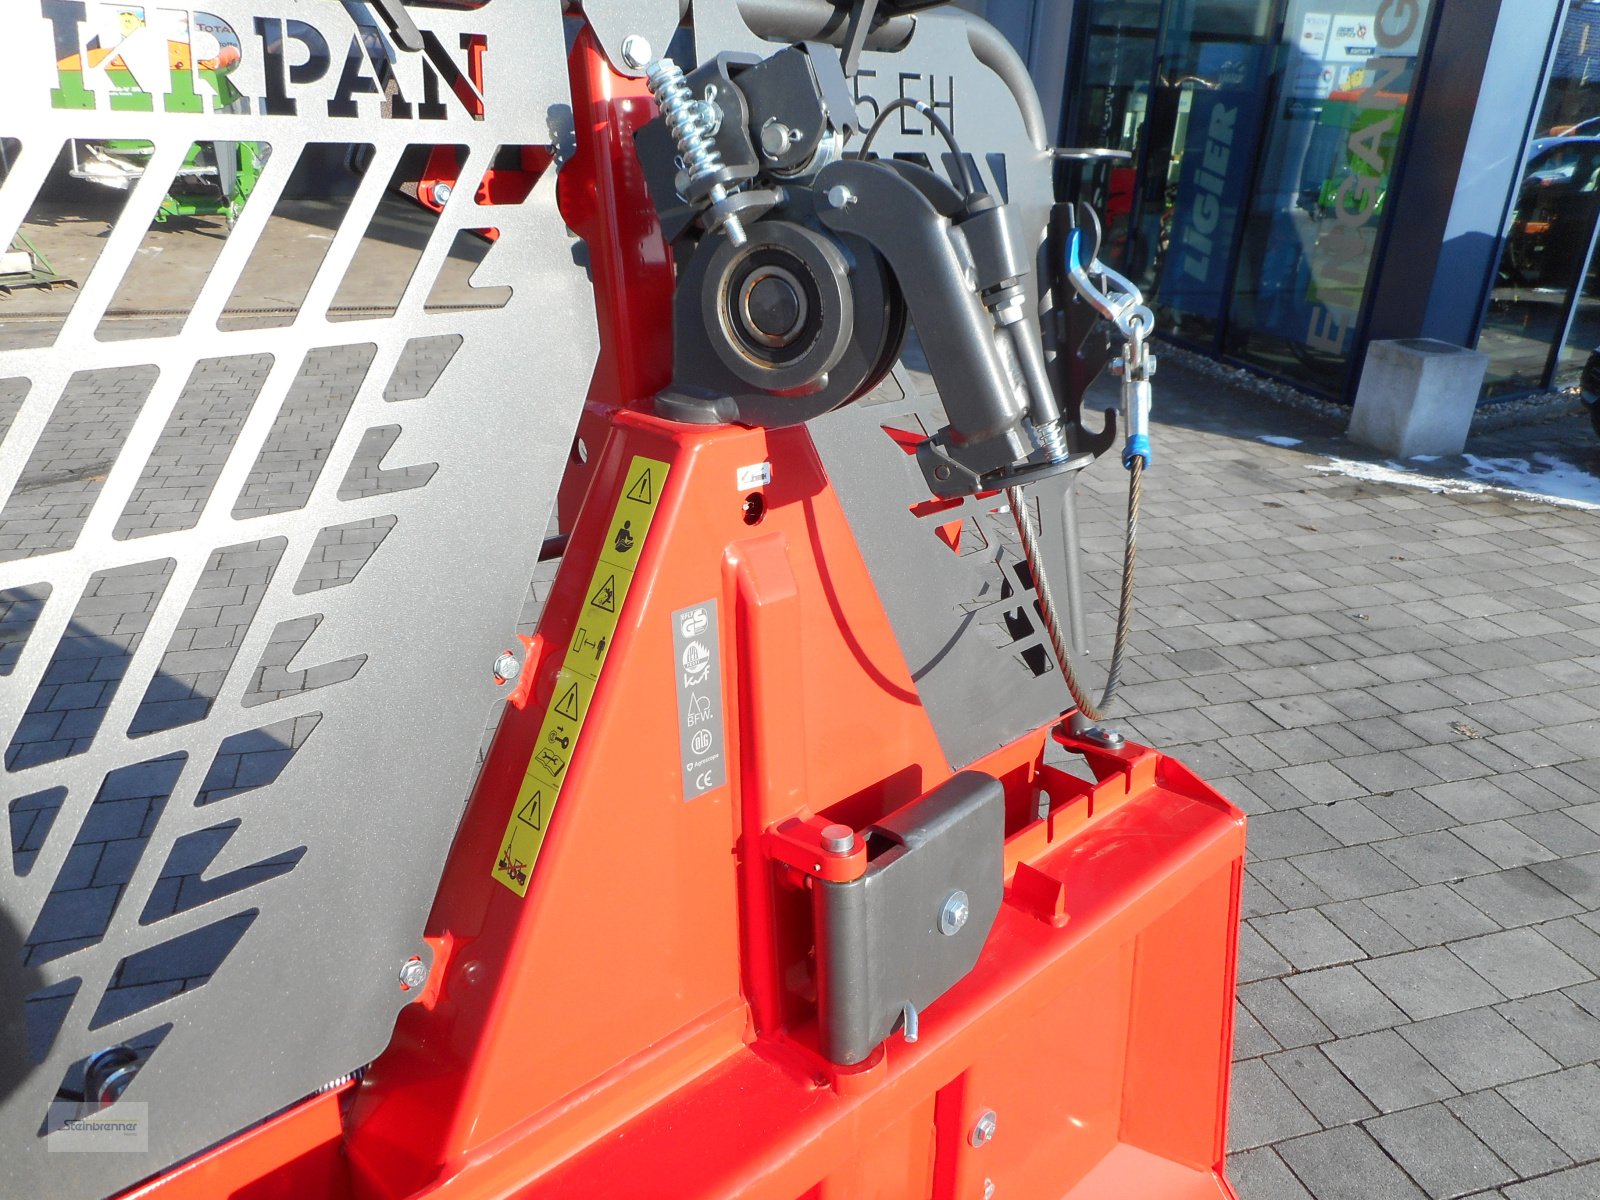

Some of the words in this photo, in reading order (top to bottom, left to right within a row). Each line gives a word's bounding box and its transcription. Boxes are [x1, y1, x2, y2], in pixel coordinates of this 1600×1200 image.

[41, 0, 489, 121] KRPAN
[899, 72, 954, 136] EH
[1183, 102, 1238, 282] LIGIER
[1304, 0, 1419, 356] EINGANG
[696, 769, 713, 790] CE
